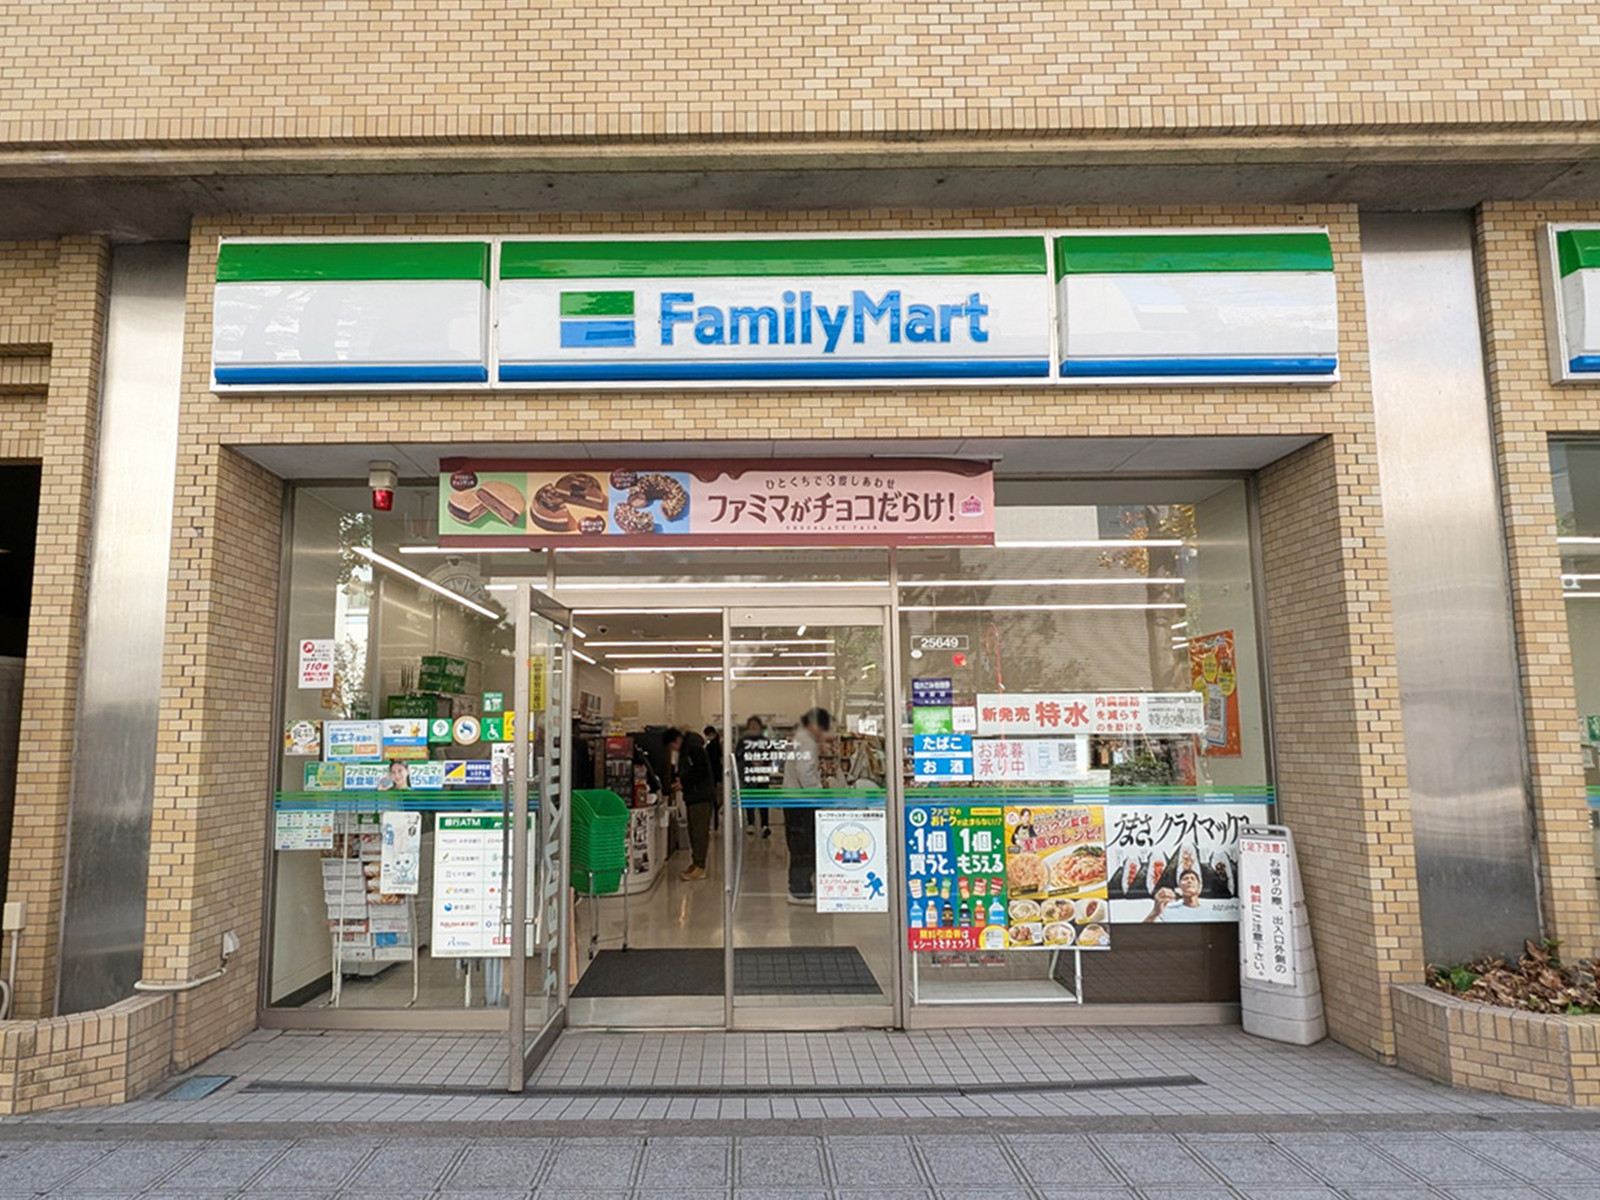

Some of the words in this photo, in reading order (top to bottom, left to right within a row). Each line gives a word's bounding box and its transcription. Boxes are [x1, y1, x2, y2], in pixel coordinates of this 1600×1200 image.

[660, 290, 989, 354] FamilyMart
[708, 491, 956, 524] ファミマがチョコだらけ!
[920, 637, 959, 648] 25649
[982, 706, 1031, 723] 新発売
[1035, 701, 1090, 728] 特水
[743, 739, 802, 750] ファミリーマート
[922, 736, 963, 751] たばこ
[978, 742, 1025, 759] お歳暮
[978, 759, 1026, 777] 承り中
[444, 817, 481, 827] 銀行ATM
[914, 828, 947, 853] 1個
[959, 828, 993, 853] 1個
[909, 853, 955, 876] 買うと、
[957, 853, 1004, 875] もらえる
